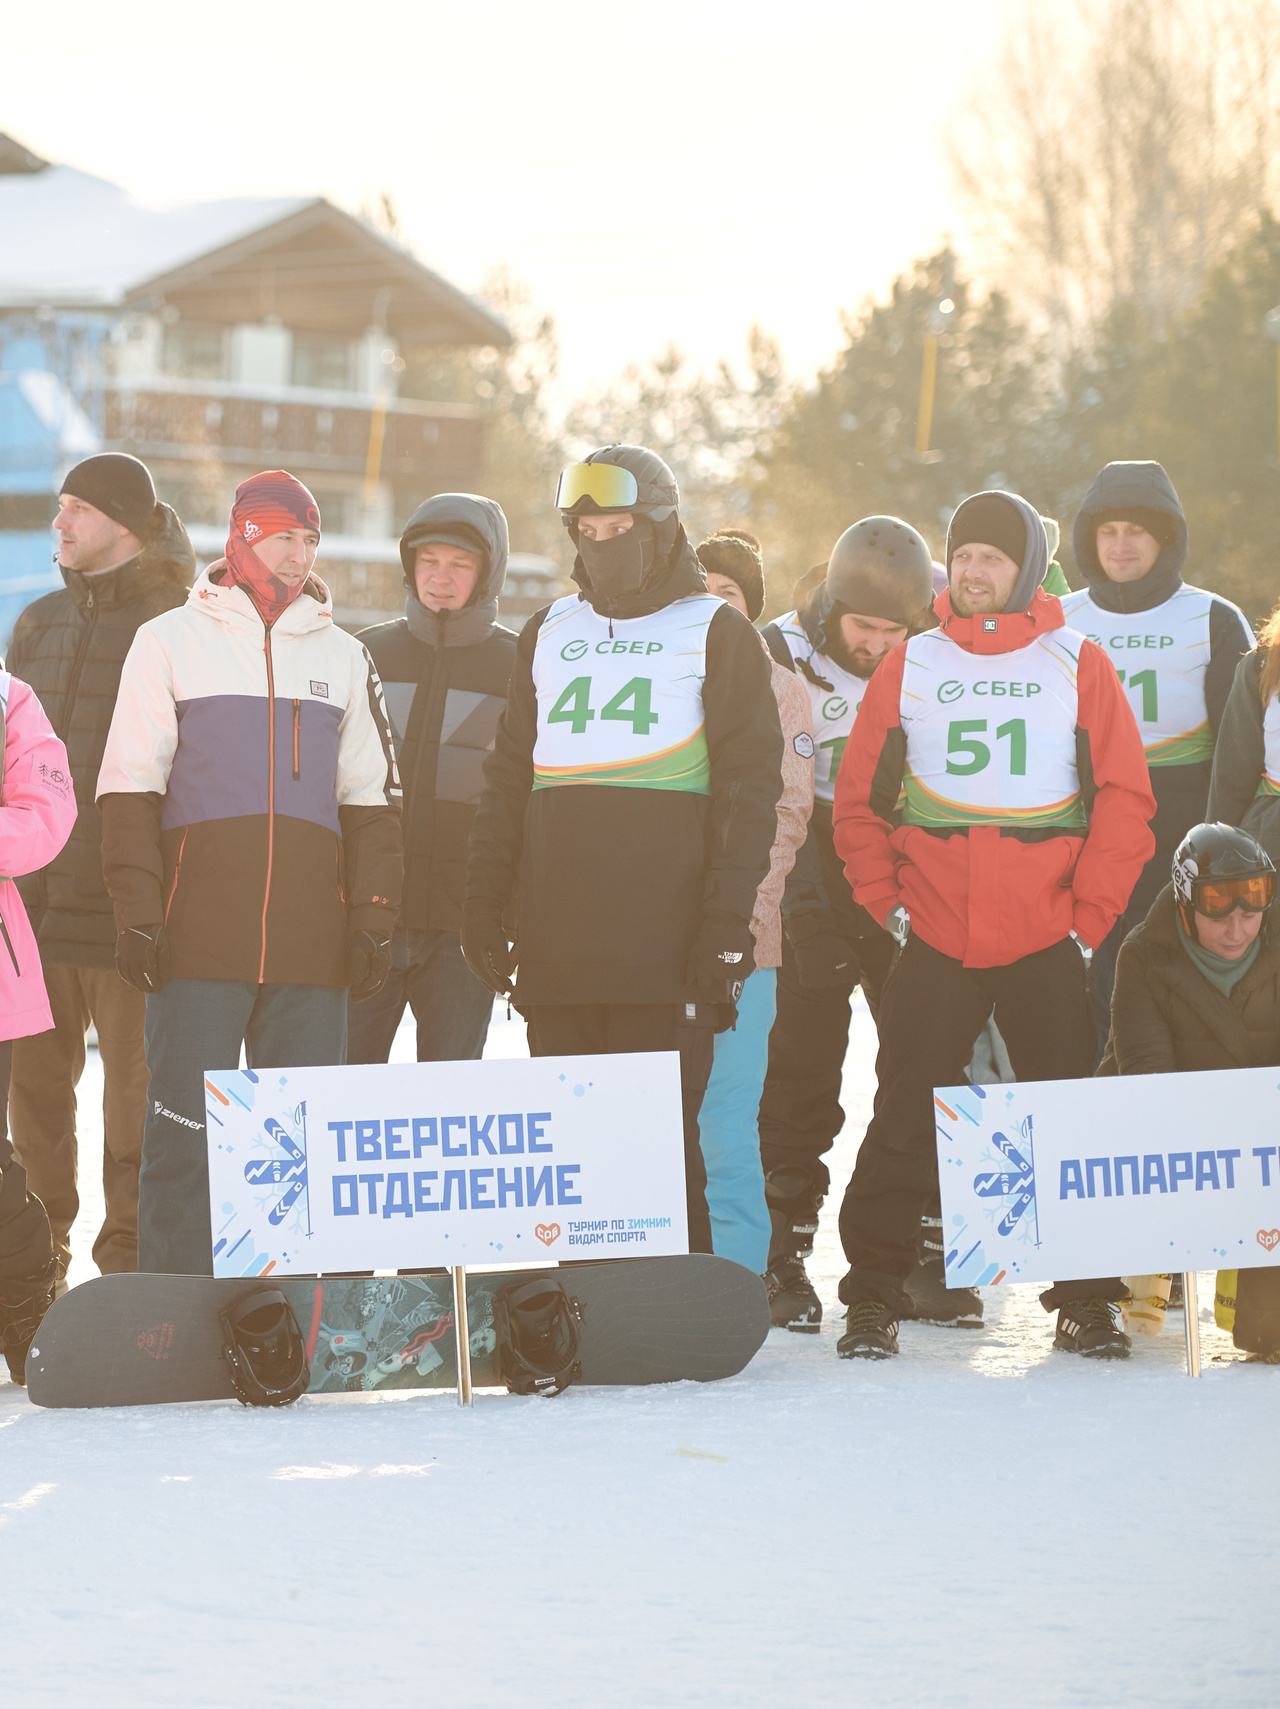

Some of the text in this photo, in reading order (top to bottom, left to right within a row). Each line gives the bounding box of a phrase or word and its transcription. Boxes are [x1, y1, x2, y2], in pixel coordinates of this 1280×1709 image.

[595, 640, 664, 656] СБЕР
[1110, 634, 1175, 649] СБЕР
[547, 676, 659, 735] 44
[972, 681, 1042, 698] СБЕР
[945, 718, 1027, 776] 51
[327, 1112, 553, 1162] ТВЕРСКОЕ
[1059, 1146, 1280, 1200] АППАРАТ Т
[332, 1164, 582, 1219] ОТДЕЛЕНИЕ
[568, 1217, 671, 1232] ТУРНИР ПО ЗИМНИМ
[568, 1231, 646, 1246] ВИДАМ СПОРТА
